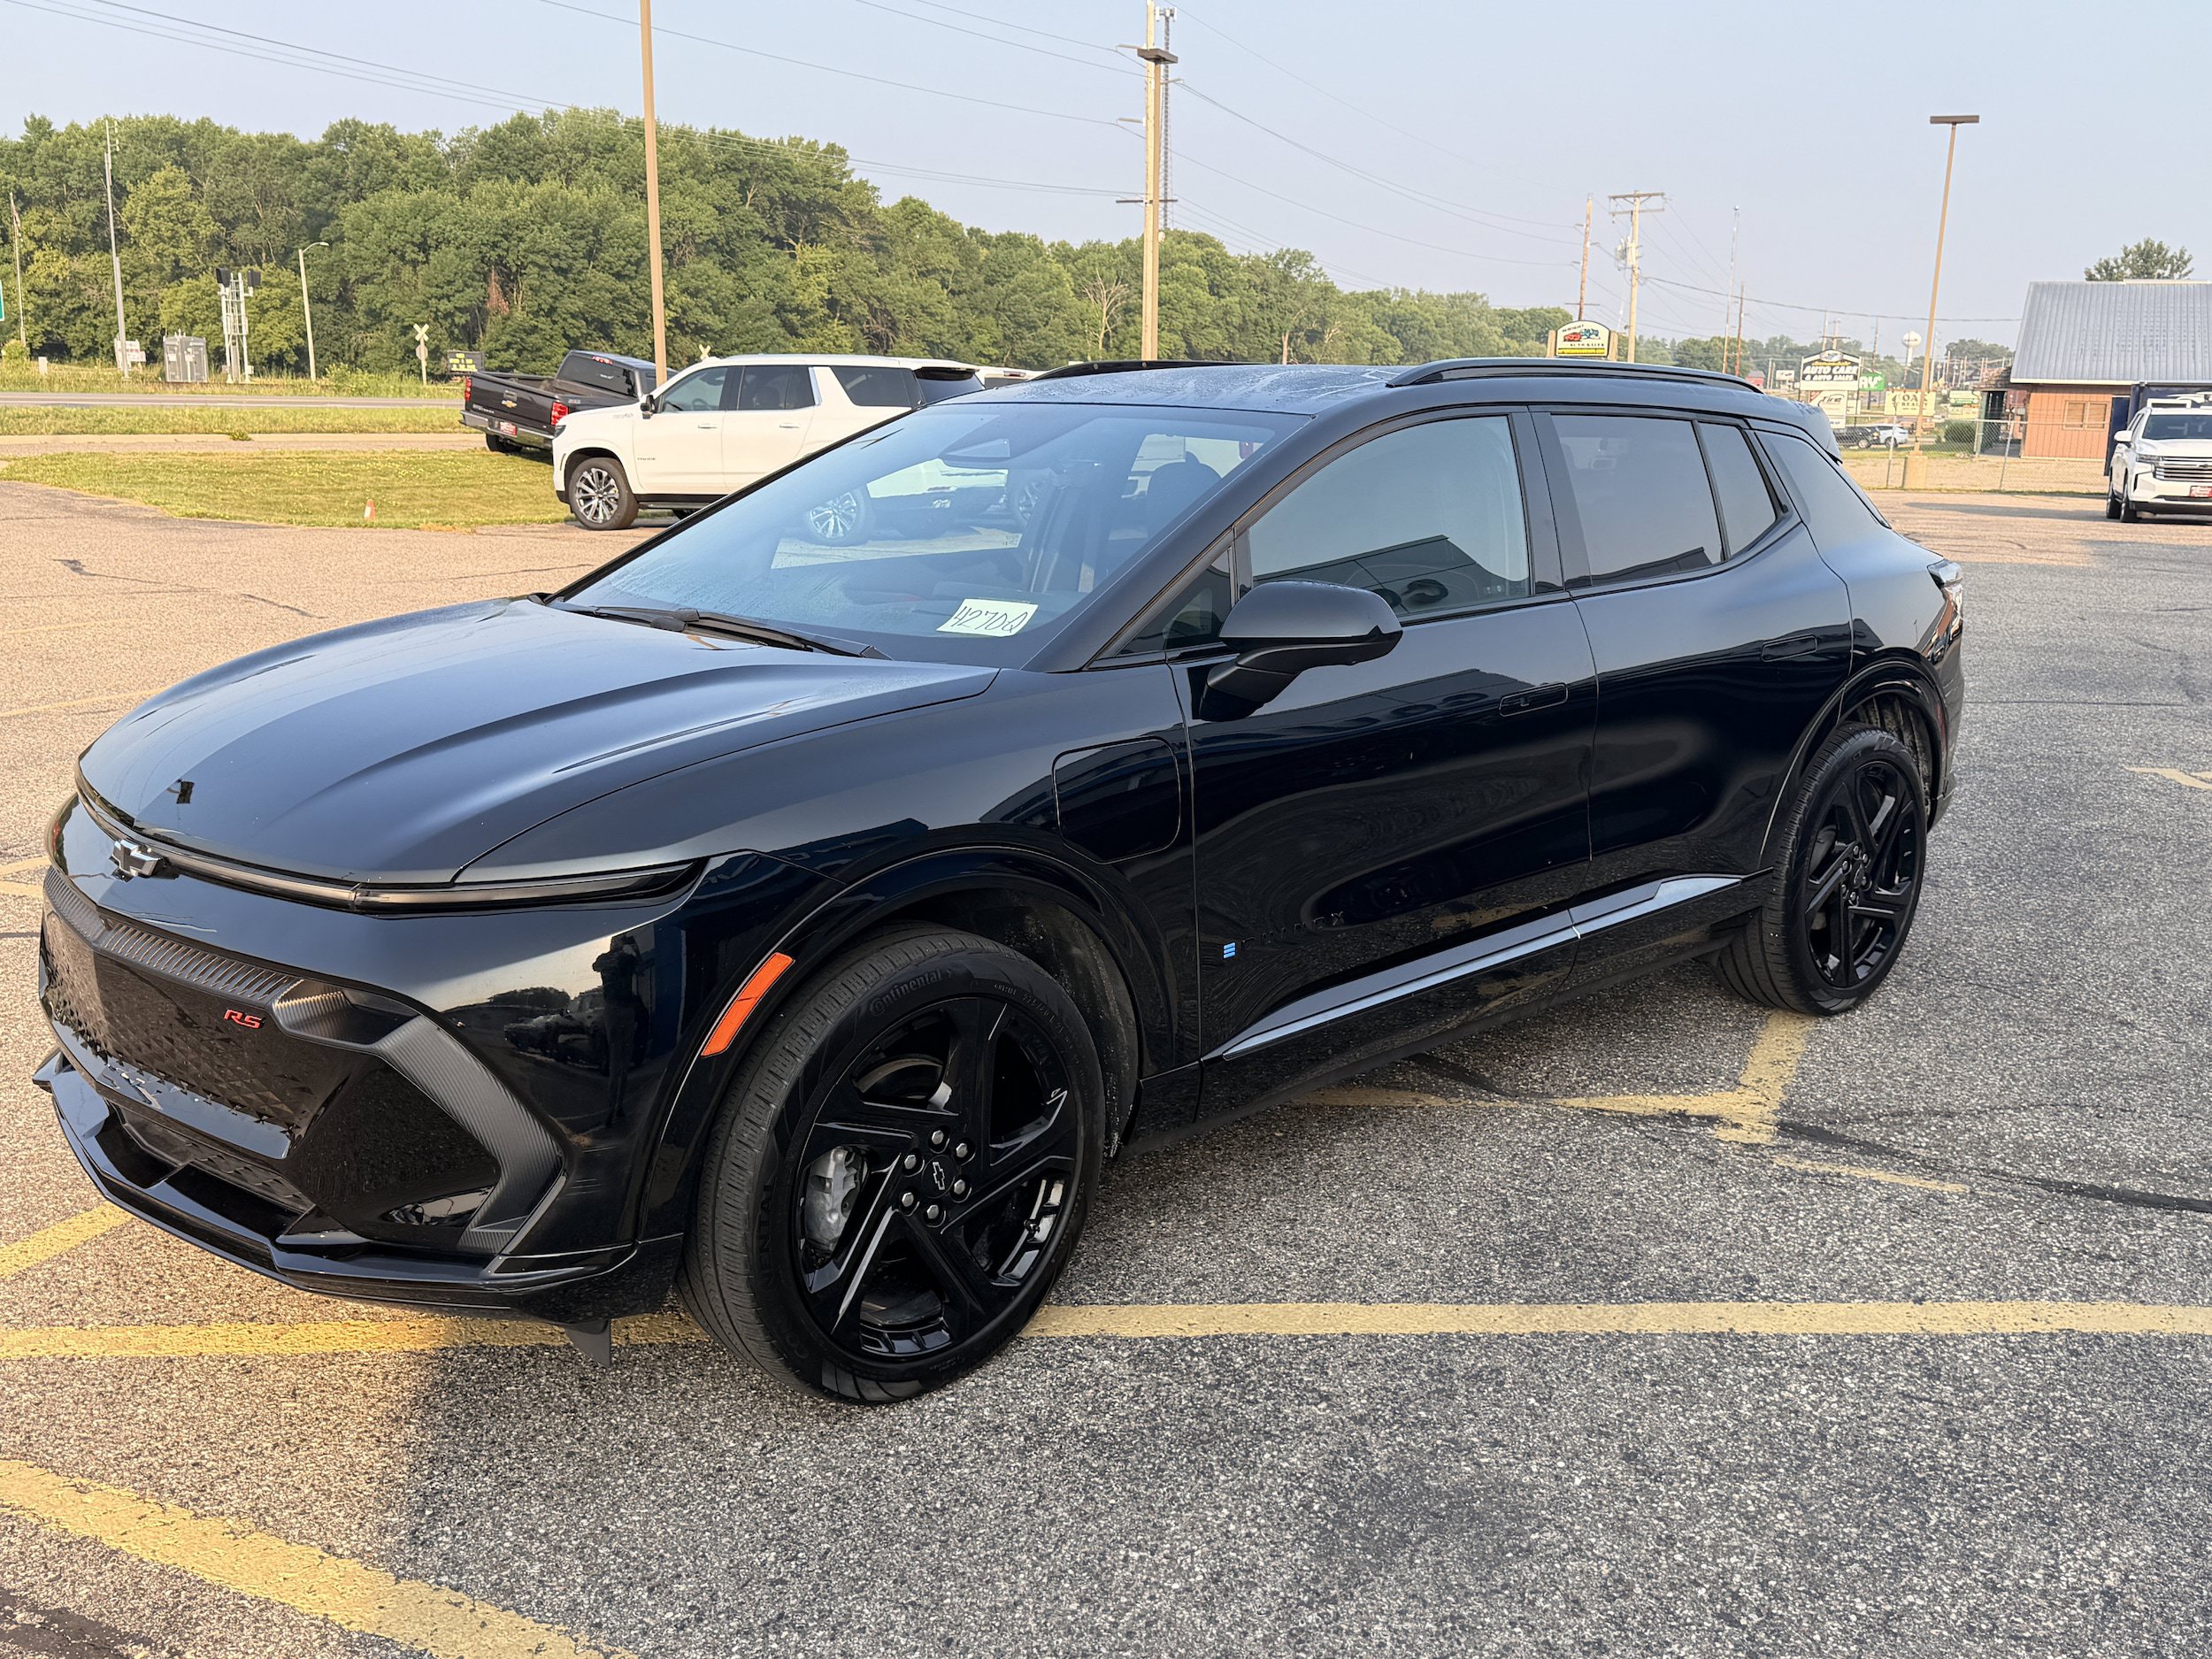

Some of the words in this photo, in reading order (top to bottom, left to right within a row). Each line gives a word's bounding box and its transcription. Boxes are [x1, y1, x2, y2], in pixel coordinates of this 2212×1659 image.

[1803, 365, 1832, 374] AUTO
[1832, 365, 1858, 374] CARE
[869, 967, 942, 1017] Continental
[224, 1010, 263, 1028] RS
[757, 1177, 810, 1361] CONNENTAL
